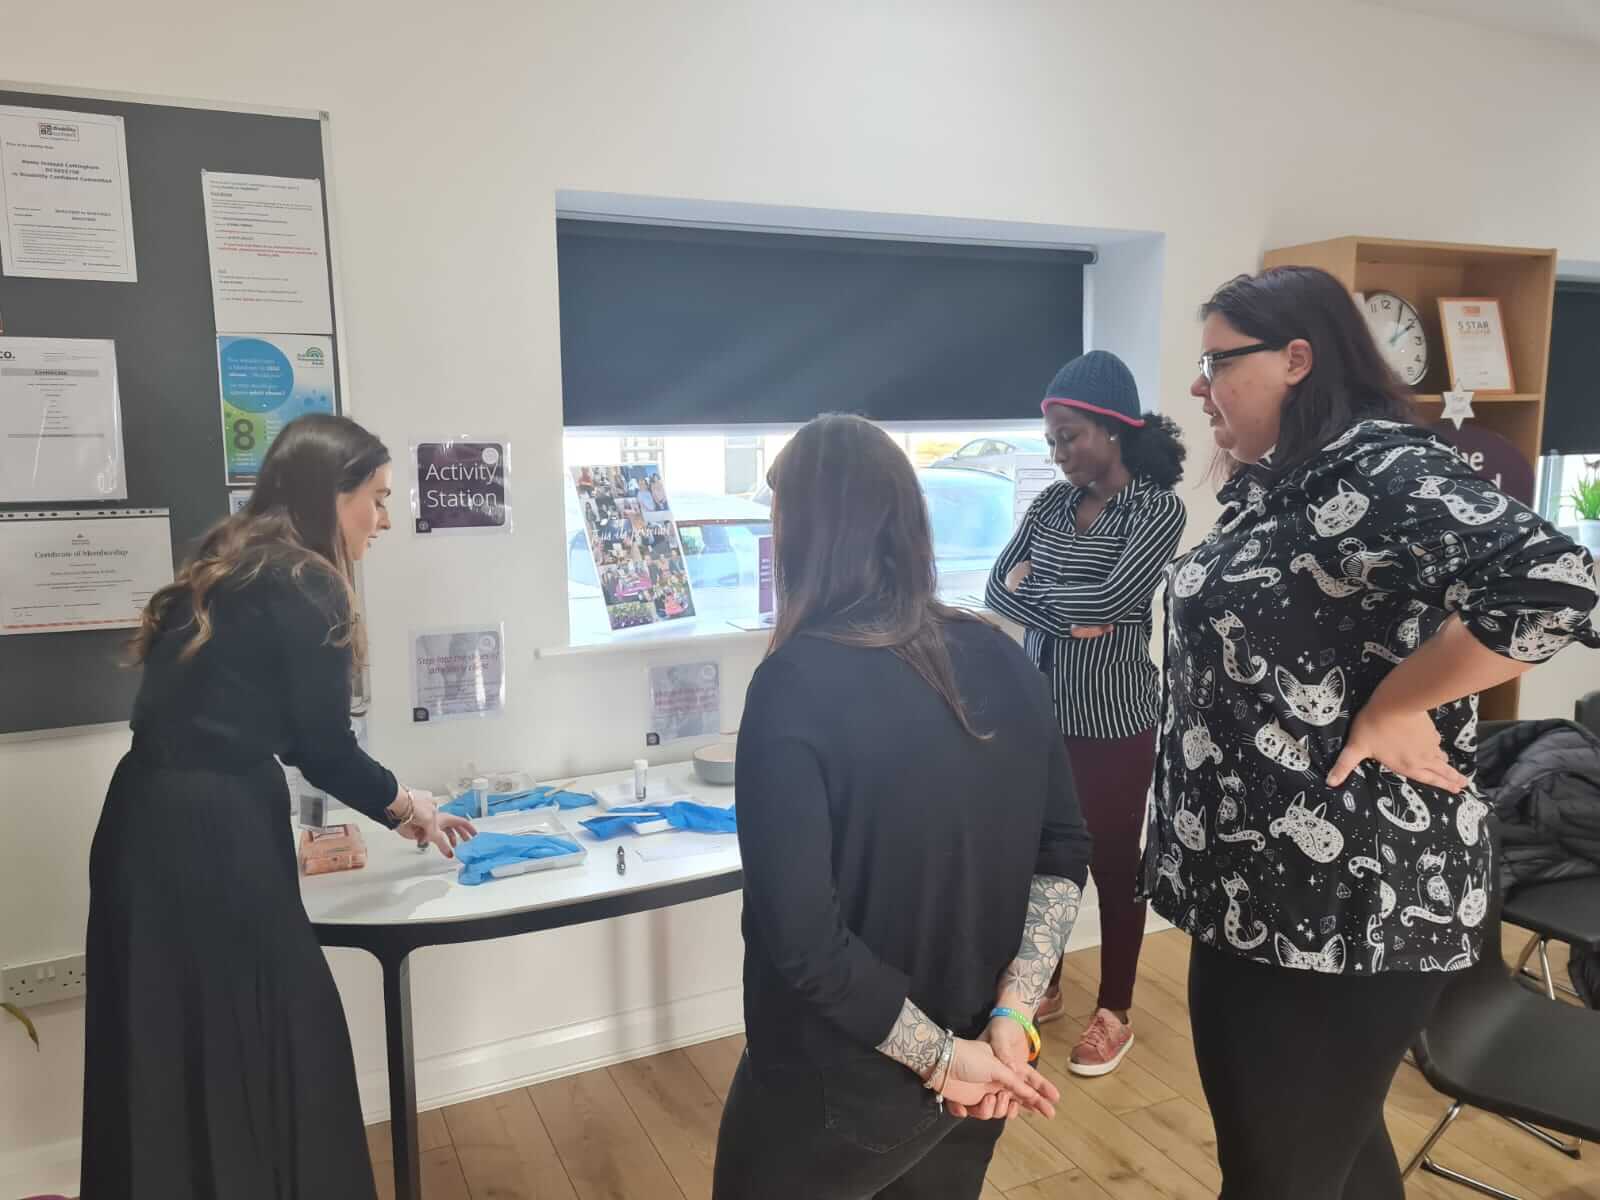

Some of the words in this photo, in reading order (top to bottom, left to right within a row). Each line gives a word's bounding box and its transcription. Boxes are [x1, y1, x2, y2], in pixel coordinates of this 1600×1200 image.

[1465, 320, 1489, 329] STAR
[1415, 336, 1422, 346] 3
[233, 418, 255, 450] 8
[425, 463, 497, 485] Activity
[426, 489, 497, 508] Station
[34, 551, 71, 559] Certificate
[83, 549, 128, 557] Membership
